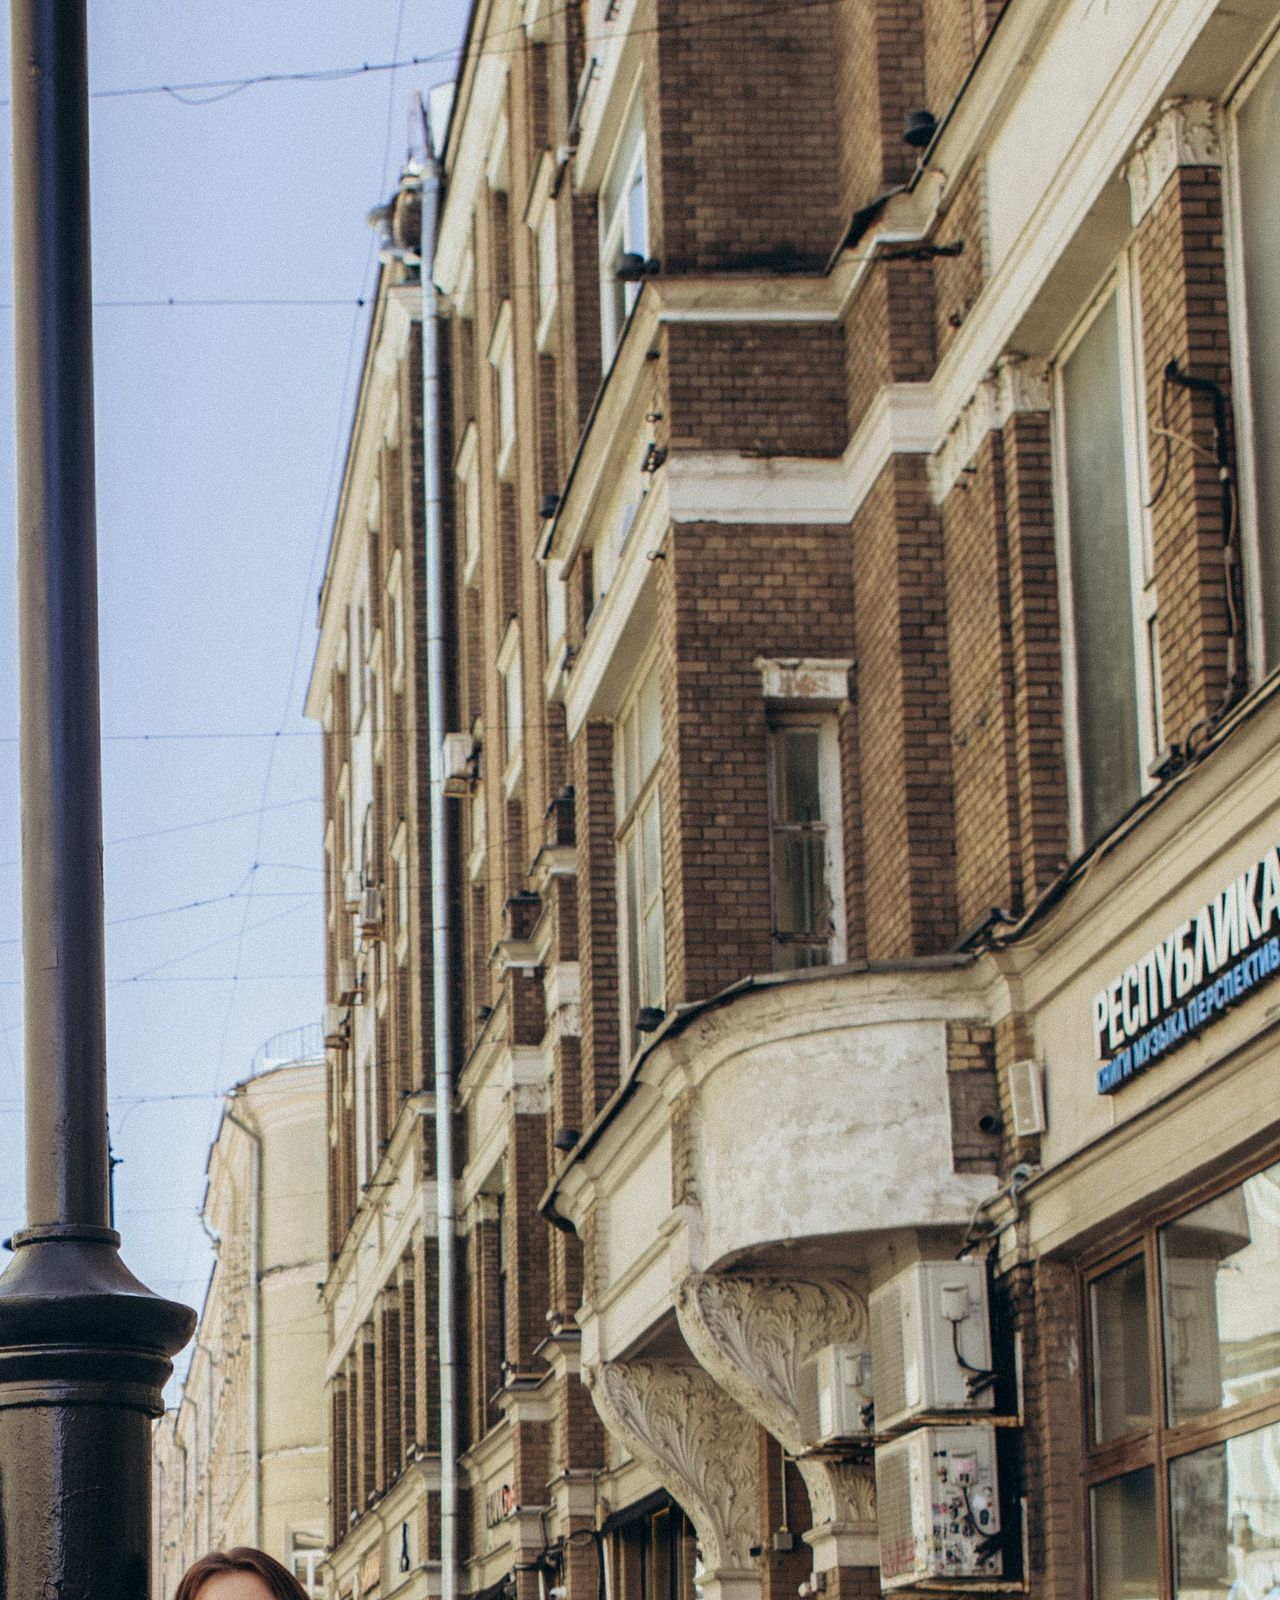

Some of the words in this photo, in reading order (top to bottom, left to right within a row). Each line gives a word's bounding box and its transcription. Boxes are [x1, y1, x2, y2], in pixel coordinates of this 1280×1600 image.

[1092, 847, 1280, 1060] РЕСПУБЛИКА
[1133, 1007, 1187, 1069] МУЗЫКА
[1187, 936, 1280, 1031] ПЕРСПЕКТИВ
